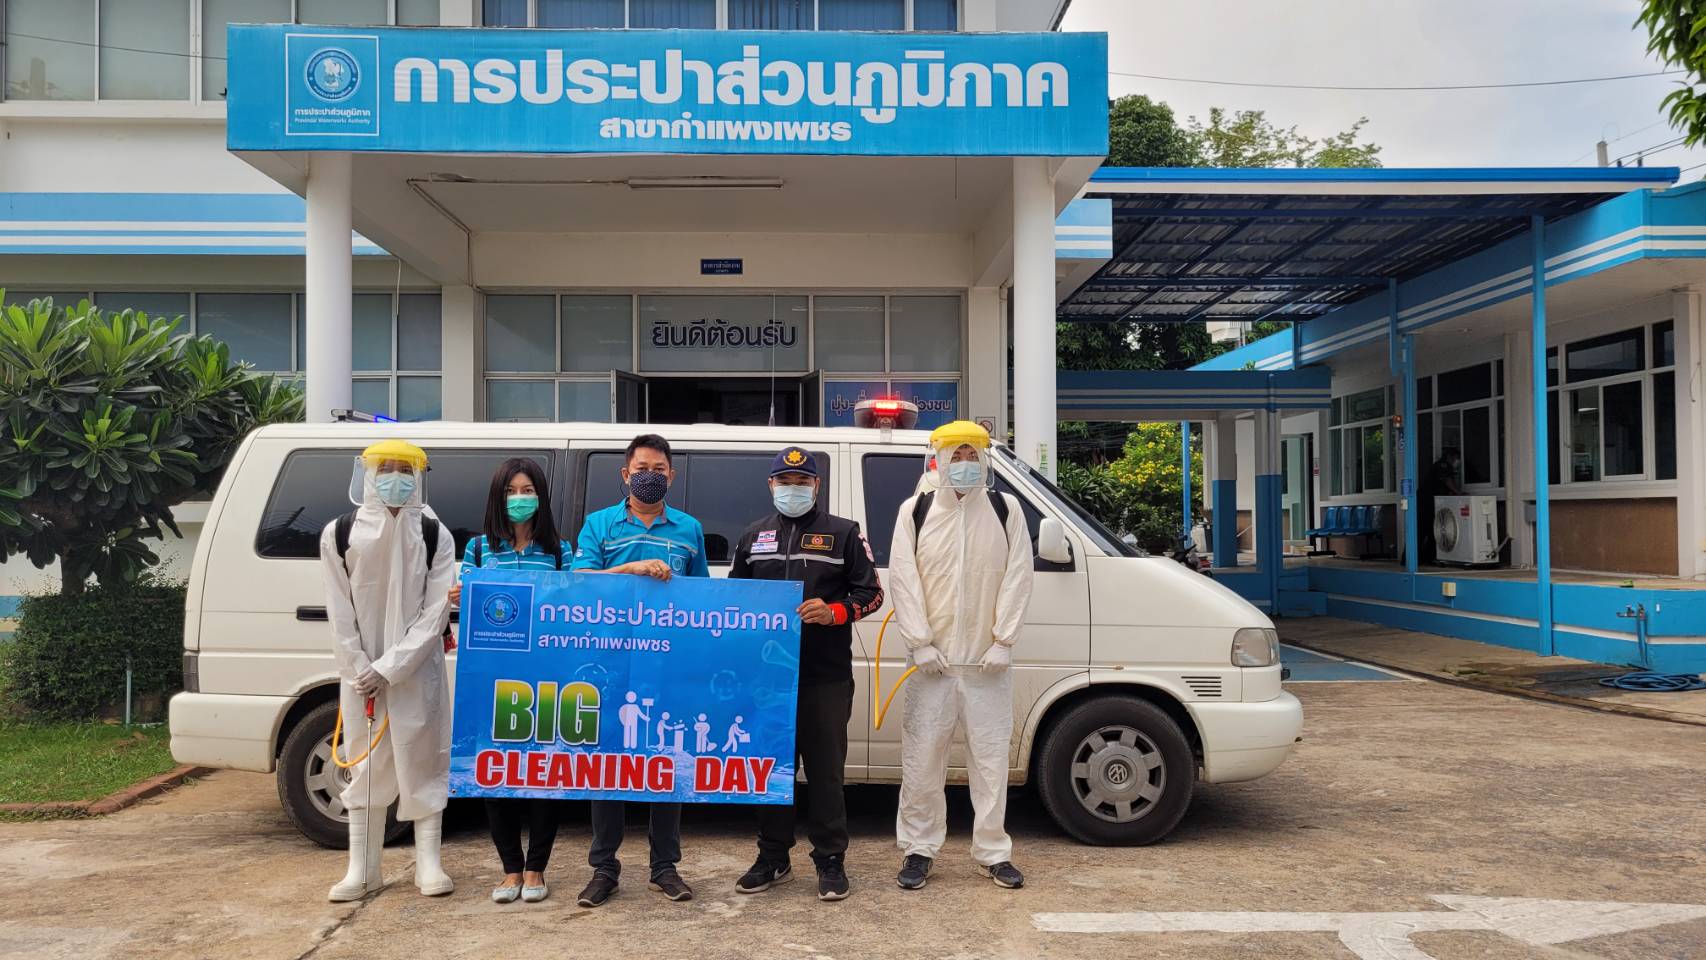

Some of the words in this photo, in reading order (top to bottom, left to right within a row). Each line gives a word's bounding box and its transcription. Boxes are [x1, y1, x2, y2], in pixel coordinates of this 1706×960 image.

[394, 45, 1069, 123] การประปาส่วนภูมิภาค
[600, 112, 853, 141] สาขากำแพงเพชร
[651, 318, 797, 347] ยินดีต้อนรับ
[539, 600, 788, 637] การประปาส่วนภูมิภาค
[538, 631, 671, 652] สาขากำแพงเพชร
[491, 679, 600, 746] BIG
[475, 749, 675, 793] CLEANING
[694, 755, 776, 794] DAY
